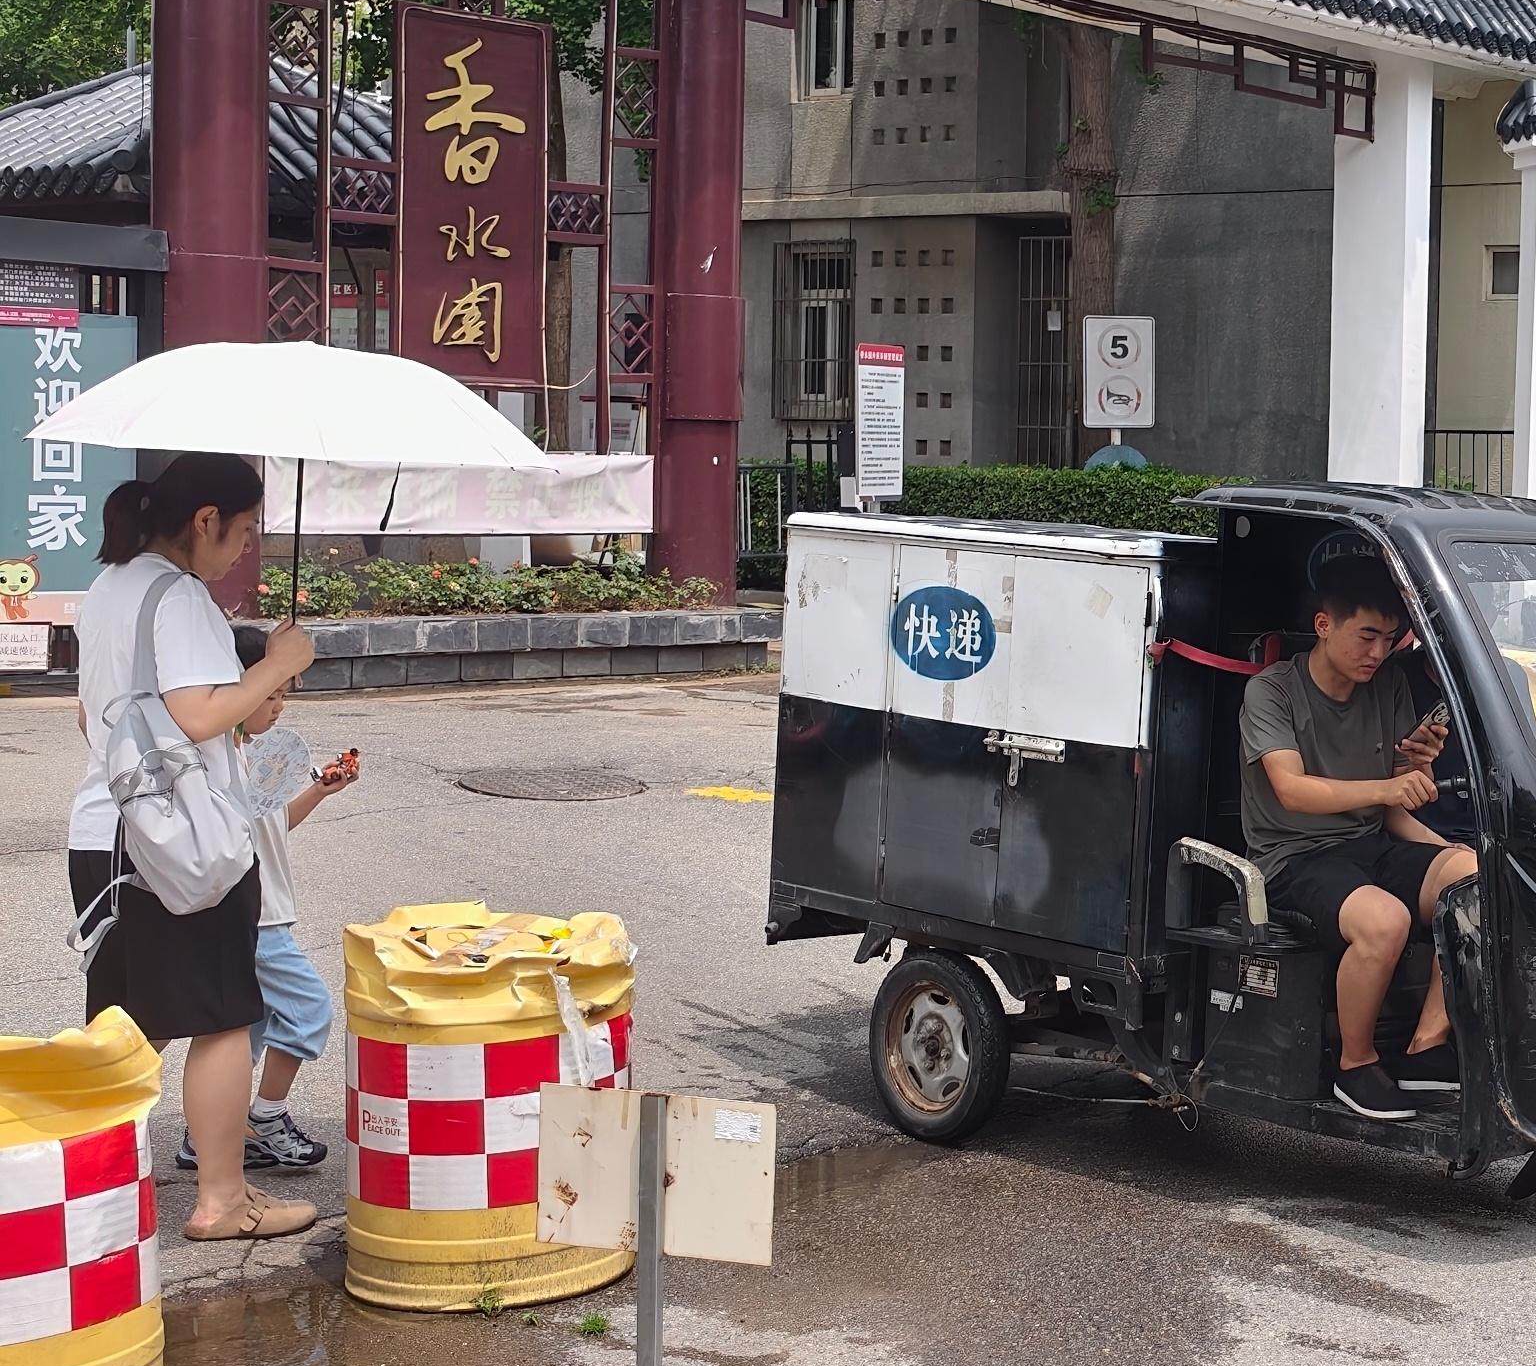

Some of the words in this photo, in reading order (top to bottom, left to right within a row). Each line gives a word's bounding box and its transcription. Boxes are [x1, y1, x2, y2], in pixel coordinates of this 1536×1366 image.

[1110, 335, 1129, 359] 5
[26, 327, 88, 551] 欢迎回家
[904, 603, 982, 663] 快递
[385, 1127, 401, 1137] OUT
